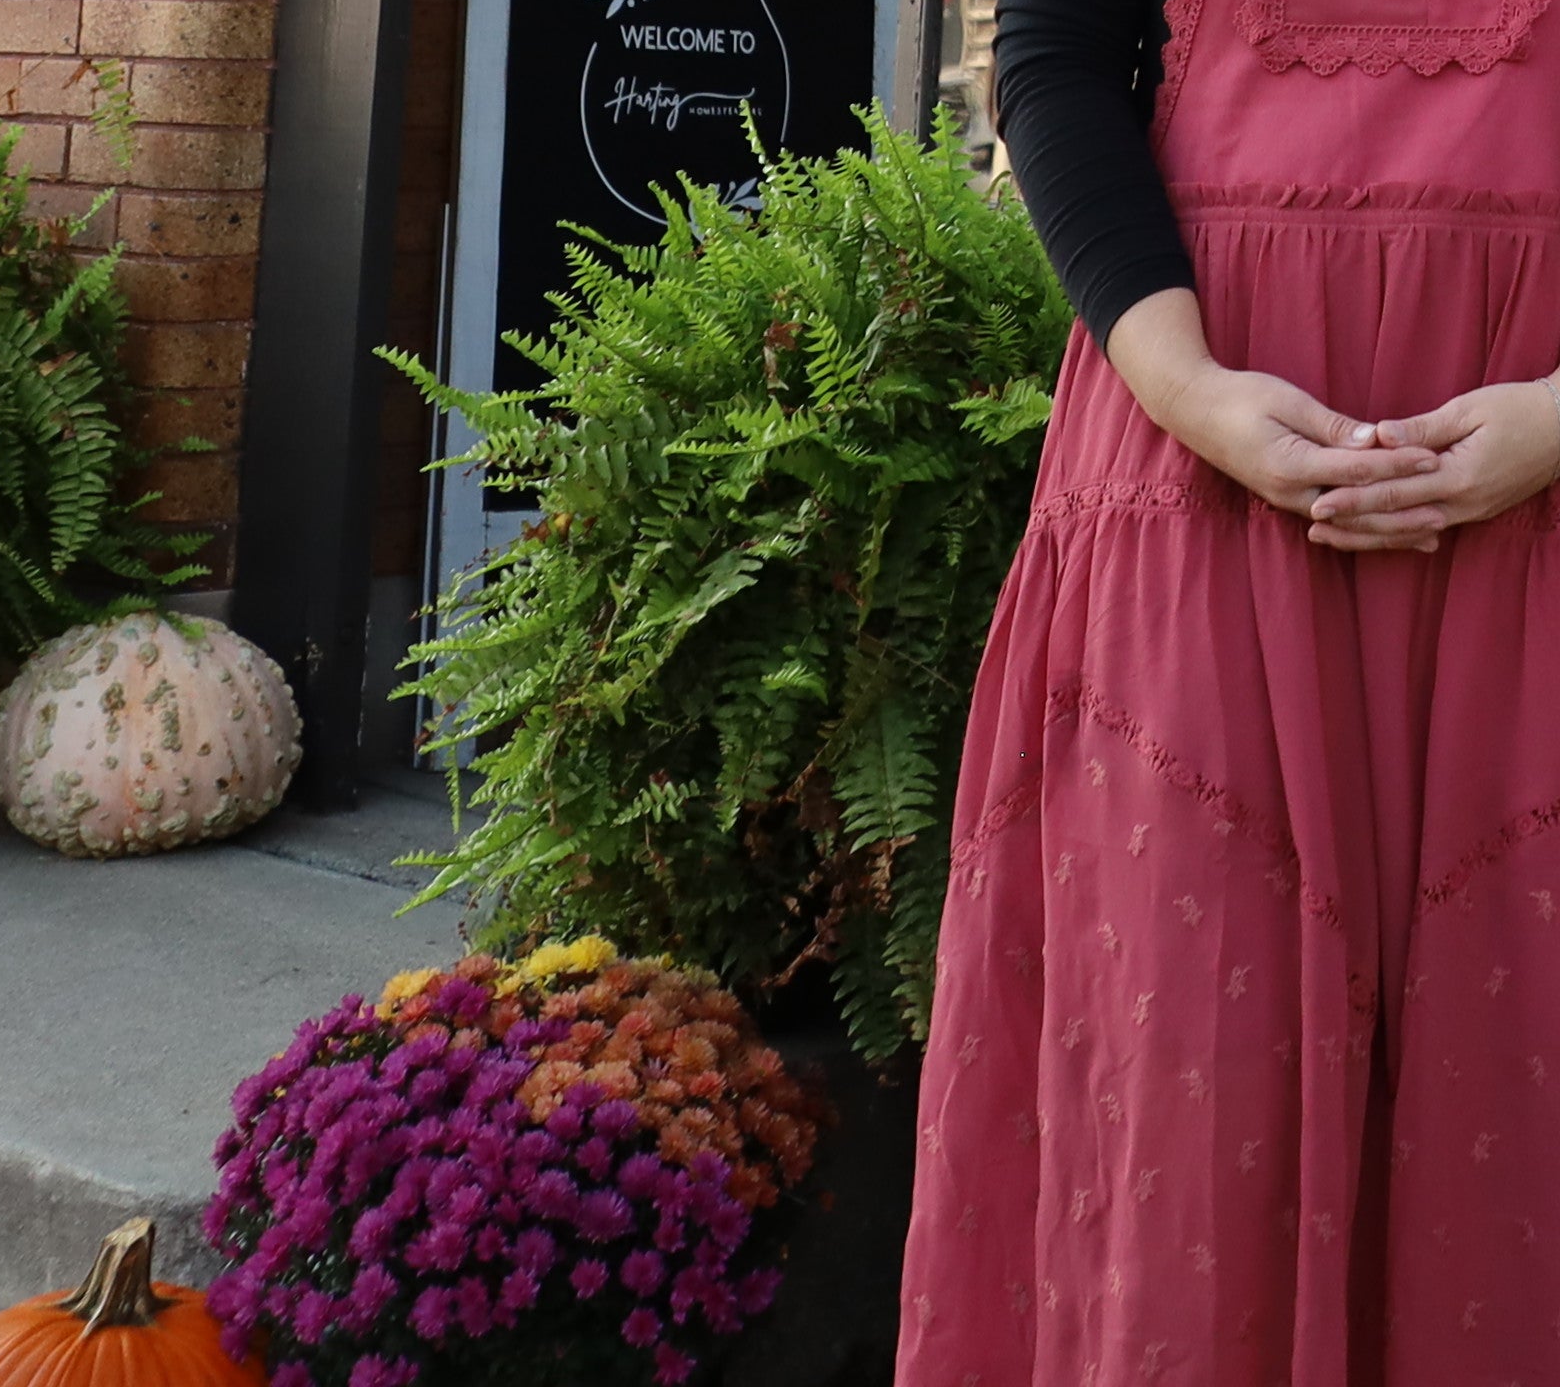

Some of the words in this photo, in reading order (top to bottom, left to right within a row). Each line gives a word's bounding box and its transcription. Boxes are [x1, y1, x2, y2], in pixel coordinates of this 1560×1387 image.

[619, 23, 726, 54] WELCOME
[730, 30, 756, 55] TO
[603, 75, 757, 132] Harting
